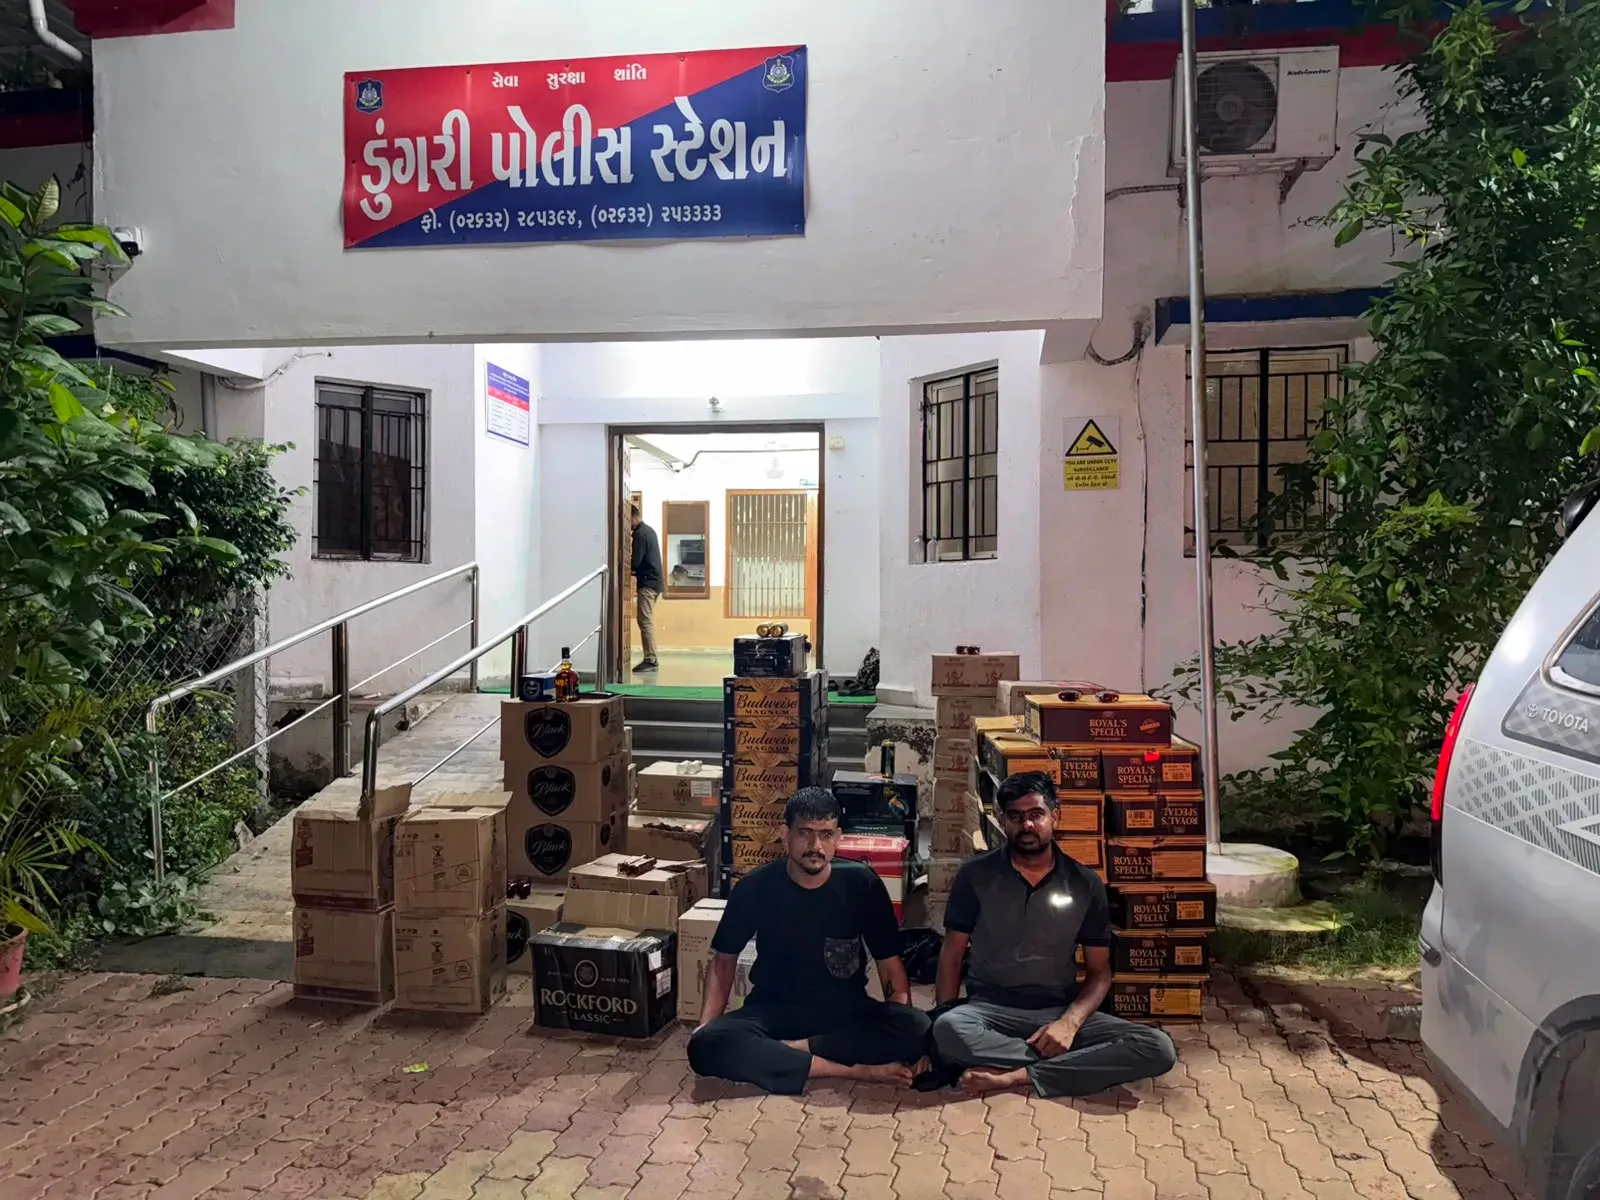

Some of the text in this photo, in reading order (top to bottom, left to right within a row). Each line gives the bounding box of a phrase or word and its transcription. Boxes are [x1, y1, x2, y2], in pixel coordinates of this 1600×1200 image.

[491, 63, 648, 90] સેવા સુરક્ષા શાંતિ
[360, 96, 787, 220] ડુંગરી પોલીસ સ્ટેશન
[421, 207, 442, 233] ફો.
[450, 207, 510, 234] (૦૨૬૩૨)
[591, 203, 653, 229] (૦૨૬૩૨)
[661, 204, 722, 223] ૨૫૩૩૩૩
[1089, 719, 1128, 728] ROYAL'S
[1542, 707, 1589, 733] TOYOTA
[1090, 728, 1127, 737] SPECIAL
[1064, 762, 1098, 770] SPECIAL
[1117, 766, 1156, 774] ROYAL'S
[1062, 770, 1098, 779] ROYAL'S
[533, 781, 572, 796] Black
[530, 840, 568, 856] Black
[1113, 856, 1152, 865] ROYAL'S
[1114, 866, 1151, 874] SPECIAL
[1133, 904, 1170, 913] ROYAL'S
[1134, 914, 1168, 922] SPECIAL
[1129, 949, 1167, 957] ROYAL'S
[1129, 958, 1166, 967] SPECIAL
[540, 988, 638, 1015] ROCKFORD
[1114, 994, 1149, 1002] ROYAL'S
[1114, 1002, 1148, 1011] SPECIAL
[568, 1010, 610, 1024] CLASSIC
